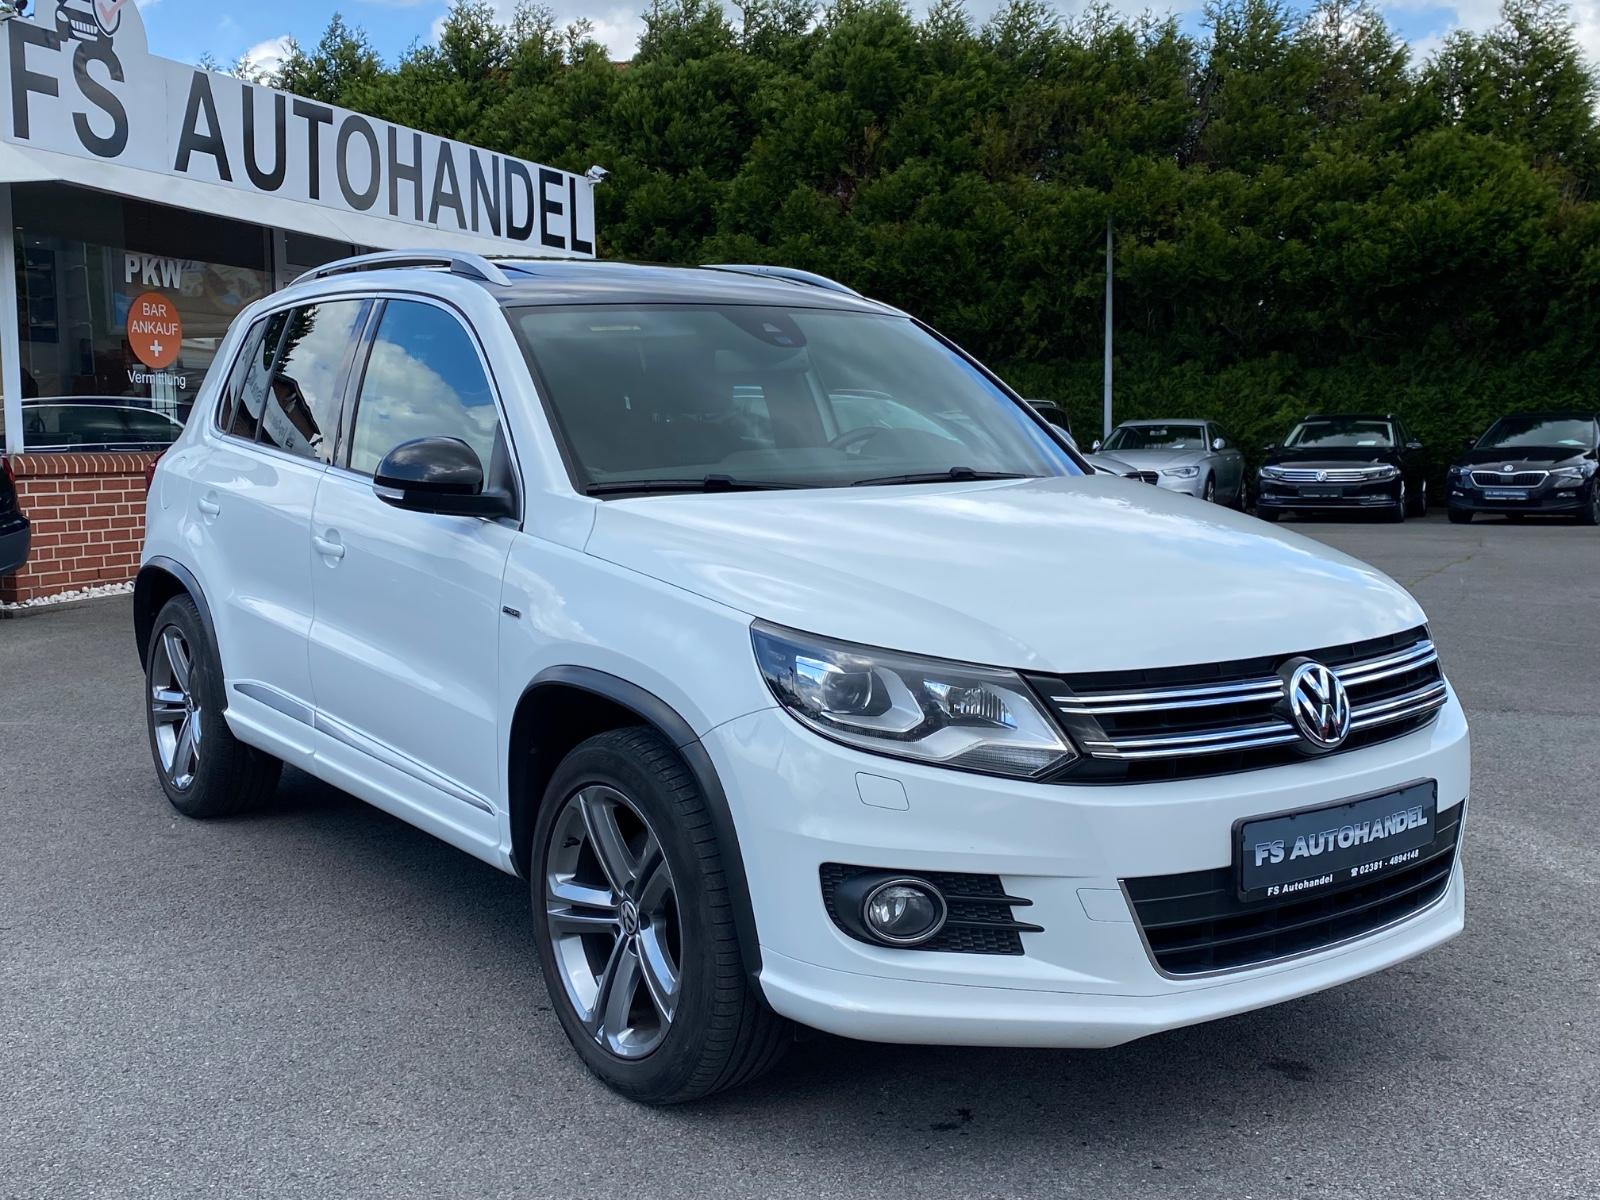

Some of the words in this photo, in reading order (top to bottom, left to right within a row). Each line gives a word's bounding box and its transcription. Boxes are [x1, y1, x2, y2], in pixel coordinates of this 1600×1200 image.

[8, 18, 129, 158] FS
[174, 71, 593, 254] AUTOHANDEL
[125, 254, 181, 288] PKW
[142, 302, 167, 317] BAR
[131, 320, 179, 336] ANKAUF
[127, 369, 186, 390] Vermittlung
[1256, 840, 1284, 866] FS
[1290, 806, 1427, 860] AUTOHANDEL
[1360, 861, 1382, 874] 02381
[1267, 886, 1280, 896] FS
[1282, 874, 1333, 893] Autohandel
